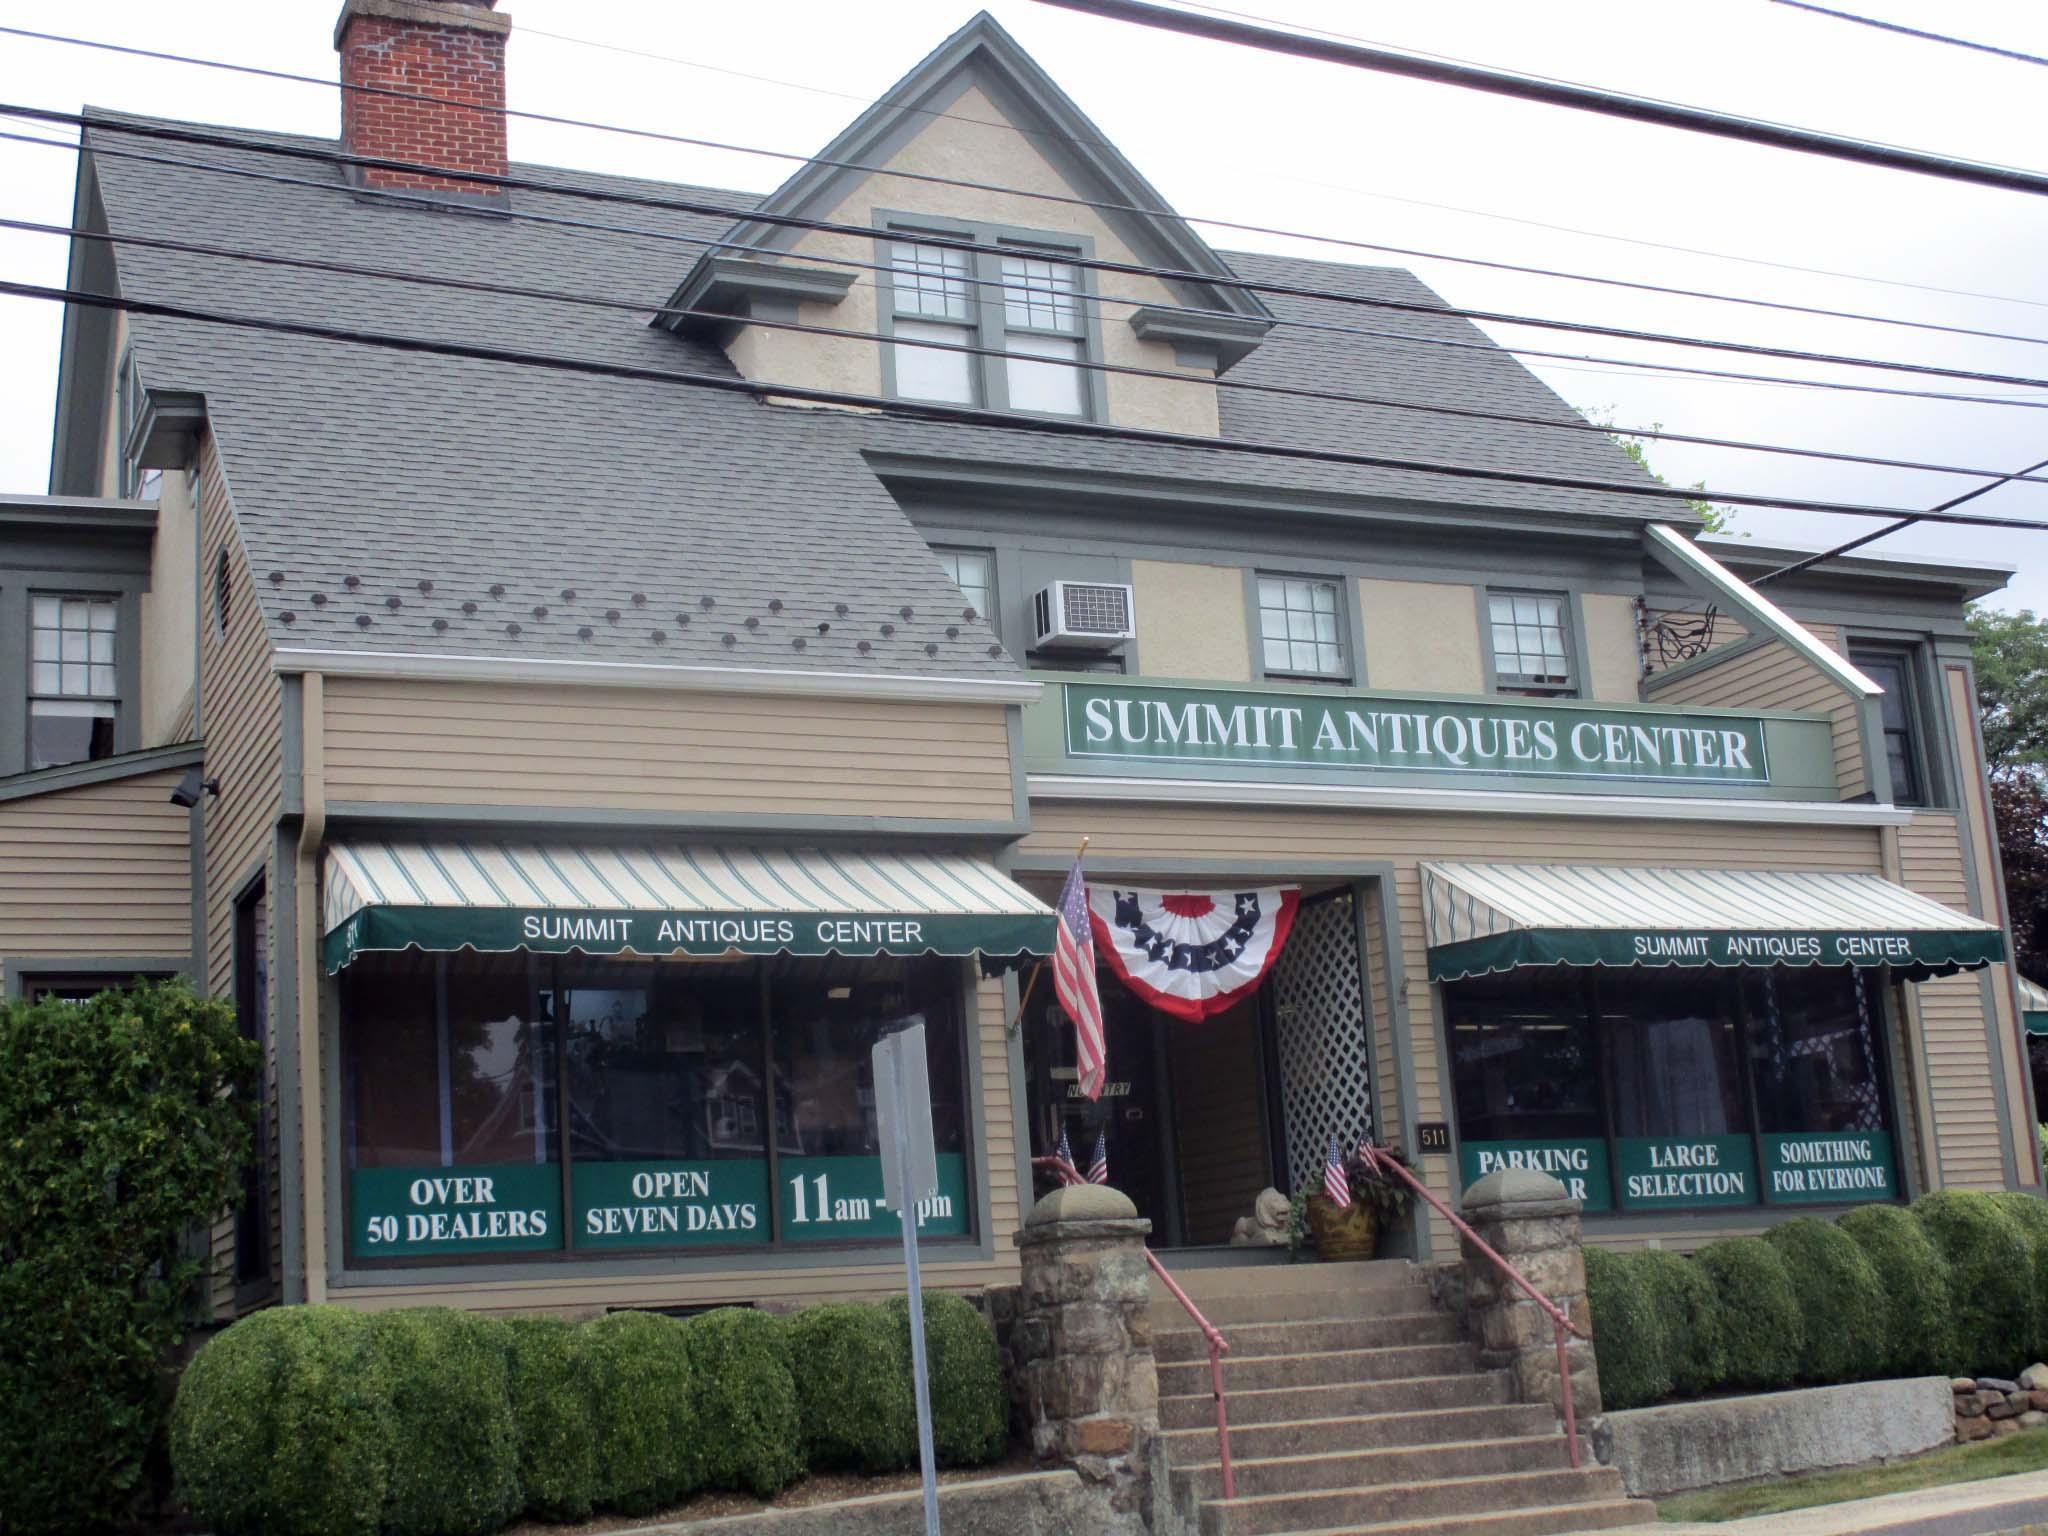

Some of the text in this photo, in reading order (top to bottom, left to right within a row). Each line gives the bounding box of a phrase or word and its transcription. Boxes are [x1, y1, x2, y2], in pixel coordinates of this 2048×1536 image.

[1085, 698, 1753, 770] SUMMIT ANTIQUES CENTER
[523, 915, 924, 944] SUMMIT ANTIQUES CENTER
[1633, 936, 1912, 957] SUMMIT ANTIQUES CENTER
[1421, 1128, 1446, 1146] 511
[1477, 1148, 1590, 1175] PARKING
[1649, 1144, 1719, 1169] LARGE
[1780, 1139, 1873, 1165] SOMETHING
[409, 1176, 497, 1206] OVER
[631, 1171, 710, 1200] OPEN
[1627, 1171, 1745, 1198] SELECTION
[1772, 1165, 1888, 1193] FOR EVERYONE
[789, 1172, 871, 1224] 11am
[366, 1209, 548, 1243] 50 DEALERS
[586, 1203, 757, 1235] SEVEN DAYS
